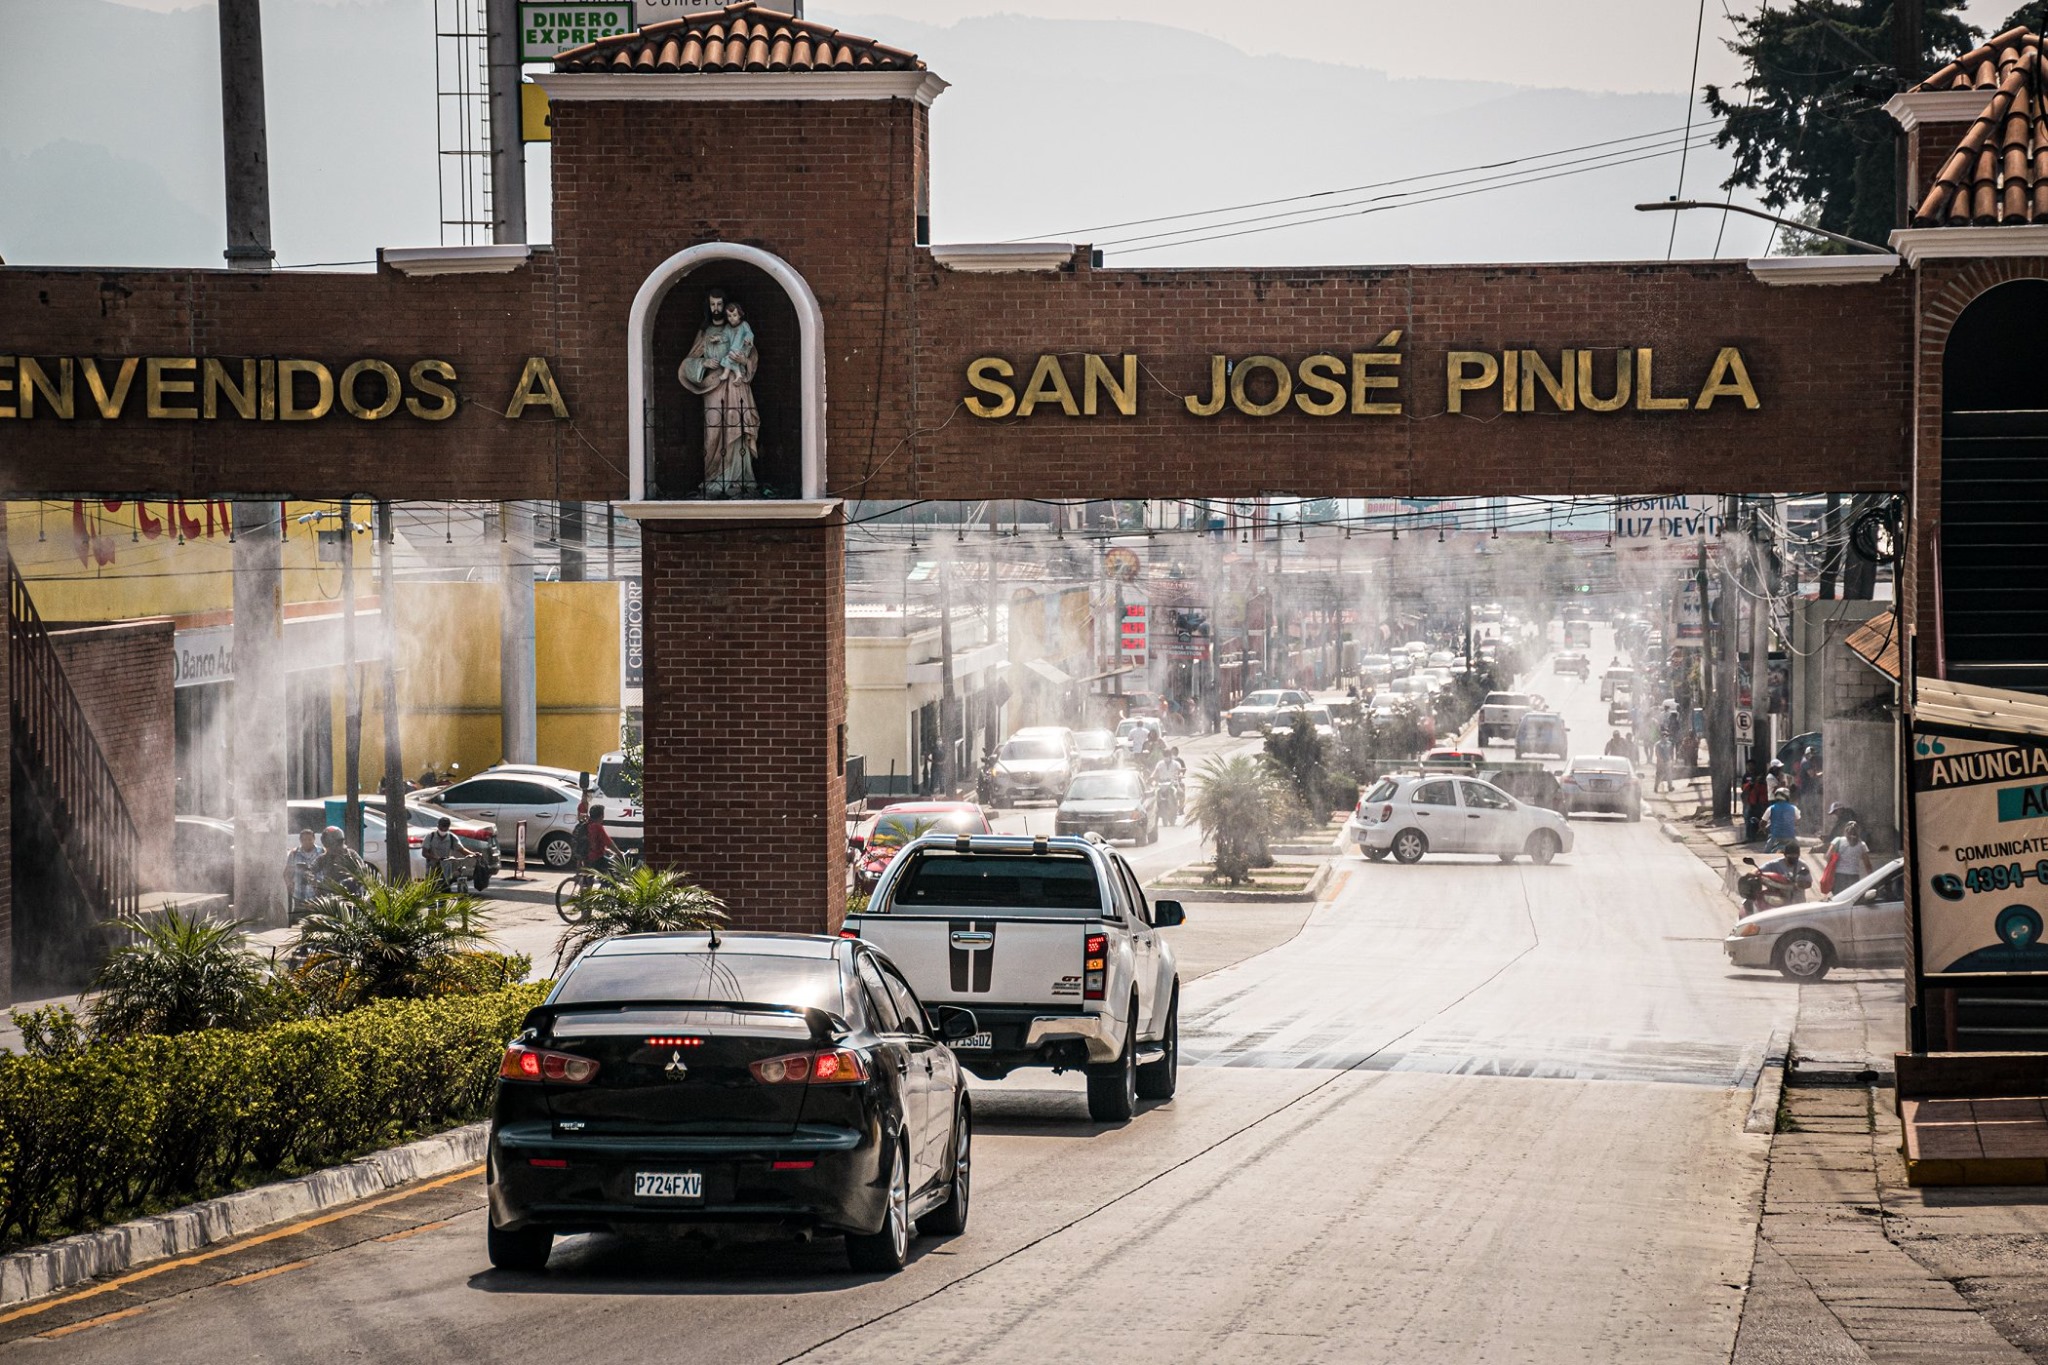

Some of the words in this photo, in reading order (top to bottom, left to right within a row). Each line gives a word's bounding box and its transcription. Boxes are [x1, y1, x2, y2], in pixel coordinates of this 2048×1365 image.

[533, 12, 618, 28] DINERO
[963, 353, 1138, 419] SAN
[1184, 329, 1403, 416] JOSÉ
[1447, 347, 1762, 413] PINULA
[0, 356, 458, 421] ENVENIDOS
[505, 356, 570, 418] A
[1618, 517, 1654, 538] LUZ
[628, 581, 643, 669] CREDICORP
[182, 649, 216, 679] Banco
[1740, 715, 1748, 727] E
[636, 1176, 701, 1195] P724FXV
